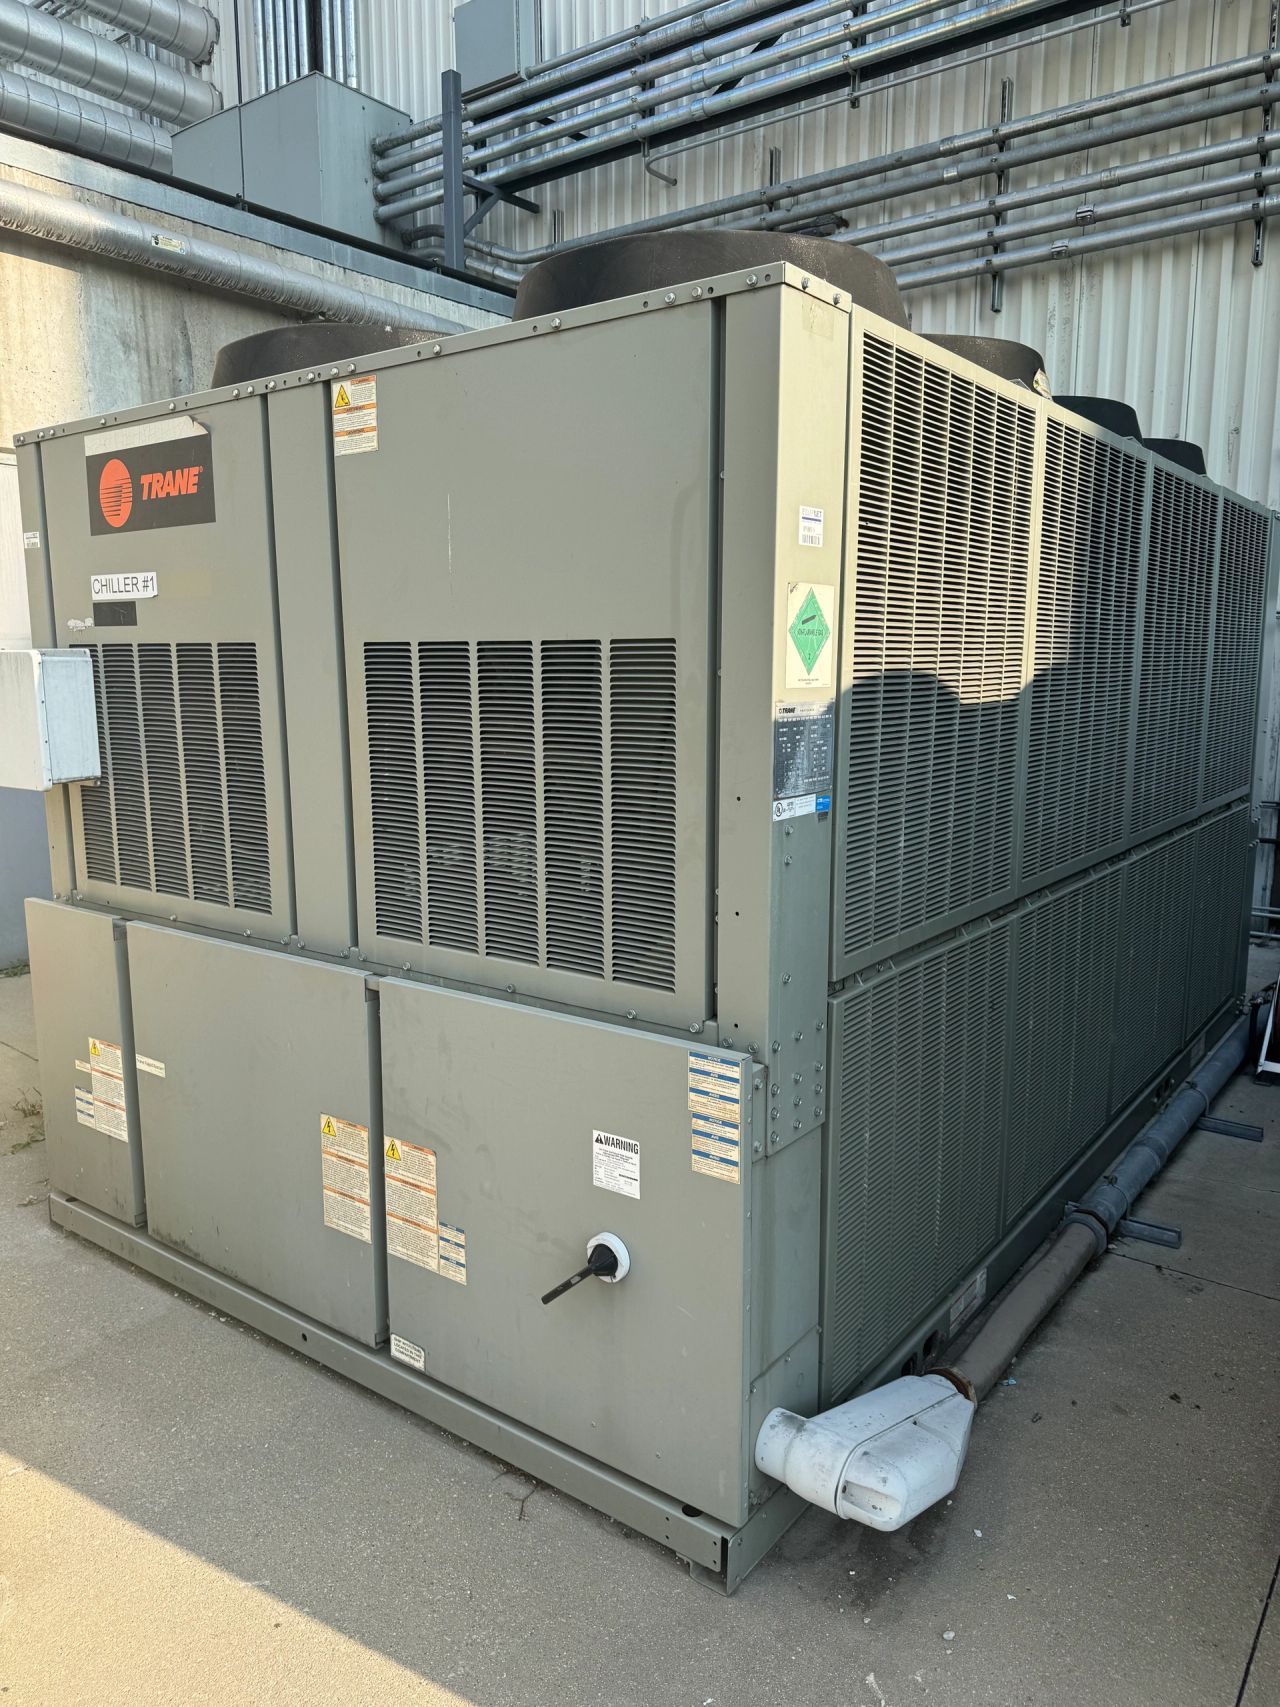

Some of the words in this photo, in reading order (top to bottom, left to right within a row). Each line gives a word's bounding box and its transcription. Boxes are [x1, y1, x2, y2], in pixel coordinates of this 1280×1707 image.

[141, 466, 200, 501] TRANE
[93, 577, 140, 594] CHILLER
[142, 576, 154, 592] #1
[603, 1134, 639, 1155] WARNING
